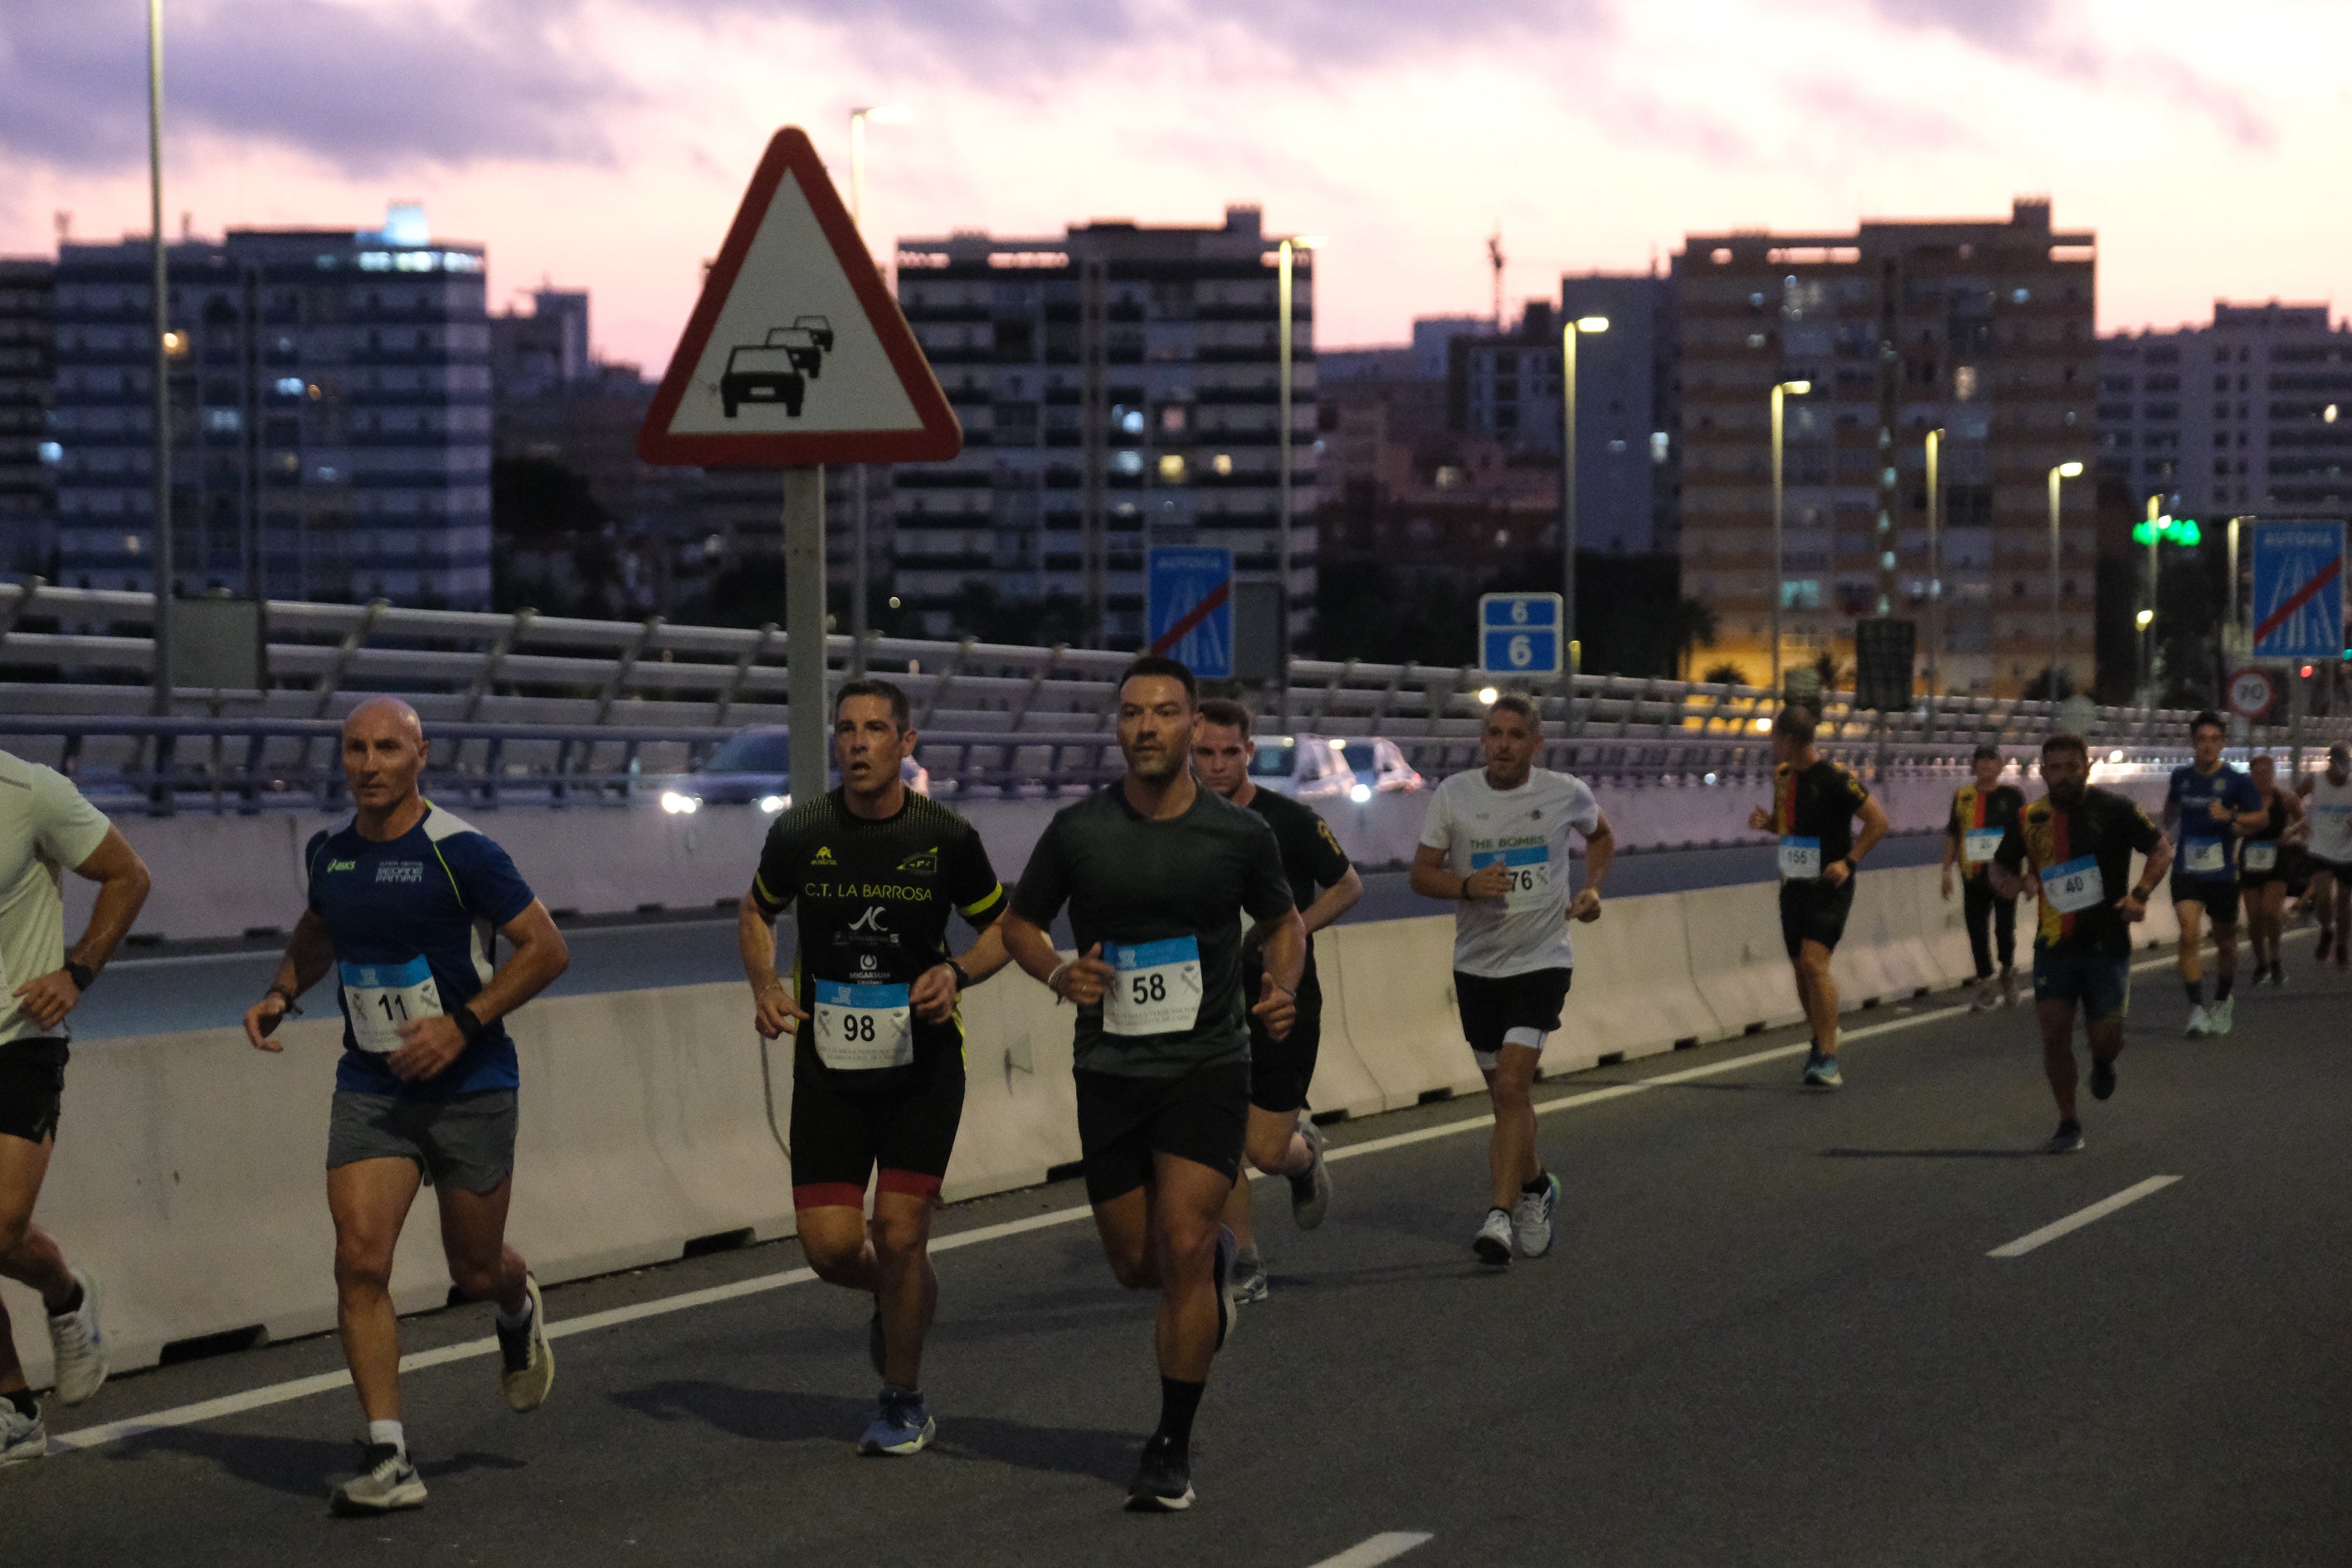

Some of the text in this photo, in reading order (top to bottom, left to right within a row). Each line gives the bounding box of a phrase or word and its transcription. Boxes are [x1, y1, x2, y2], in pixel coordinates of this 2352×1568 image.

[1512, 600, 1528, 623] 6
[1508, 635, 1532, 666] 6
[1471, 838, 1493, 849] THE
[805, 882, 933, 902] C.T. LA BARROSA
[2065, 876, 2084, 893] 40
[1132, 973, 1166, 1005] 58
[378, 994, 407, 1020] 11
[844, 1014, 875, 1042] 98
